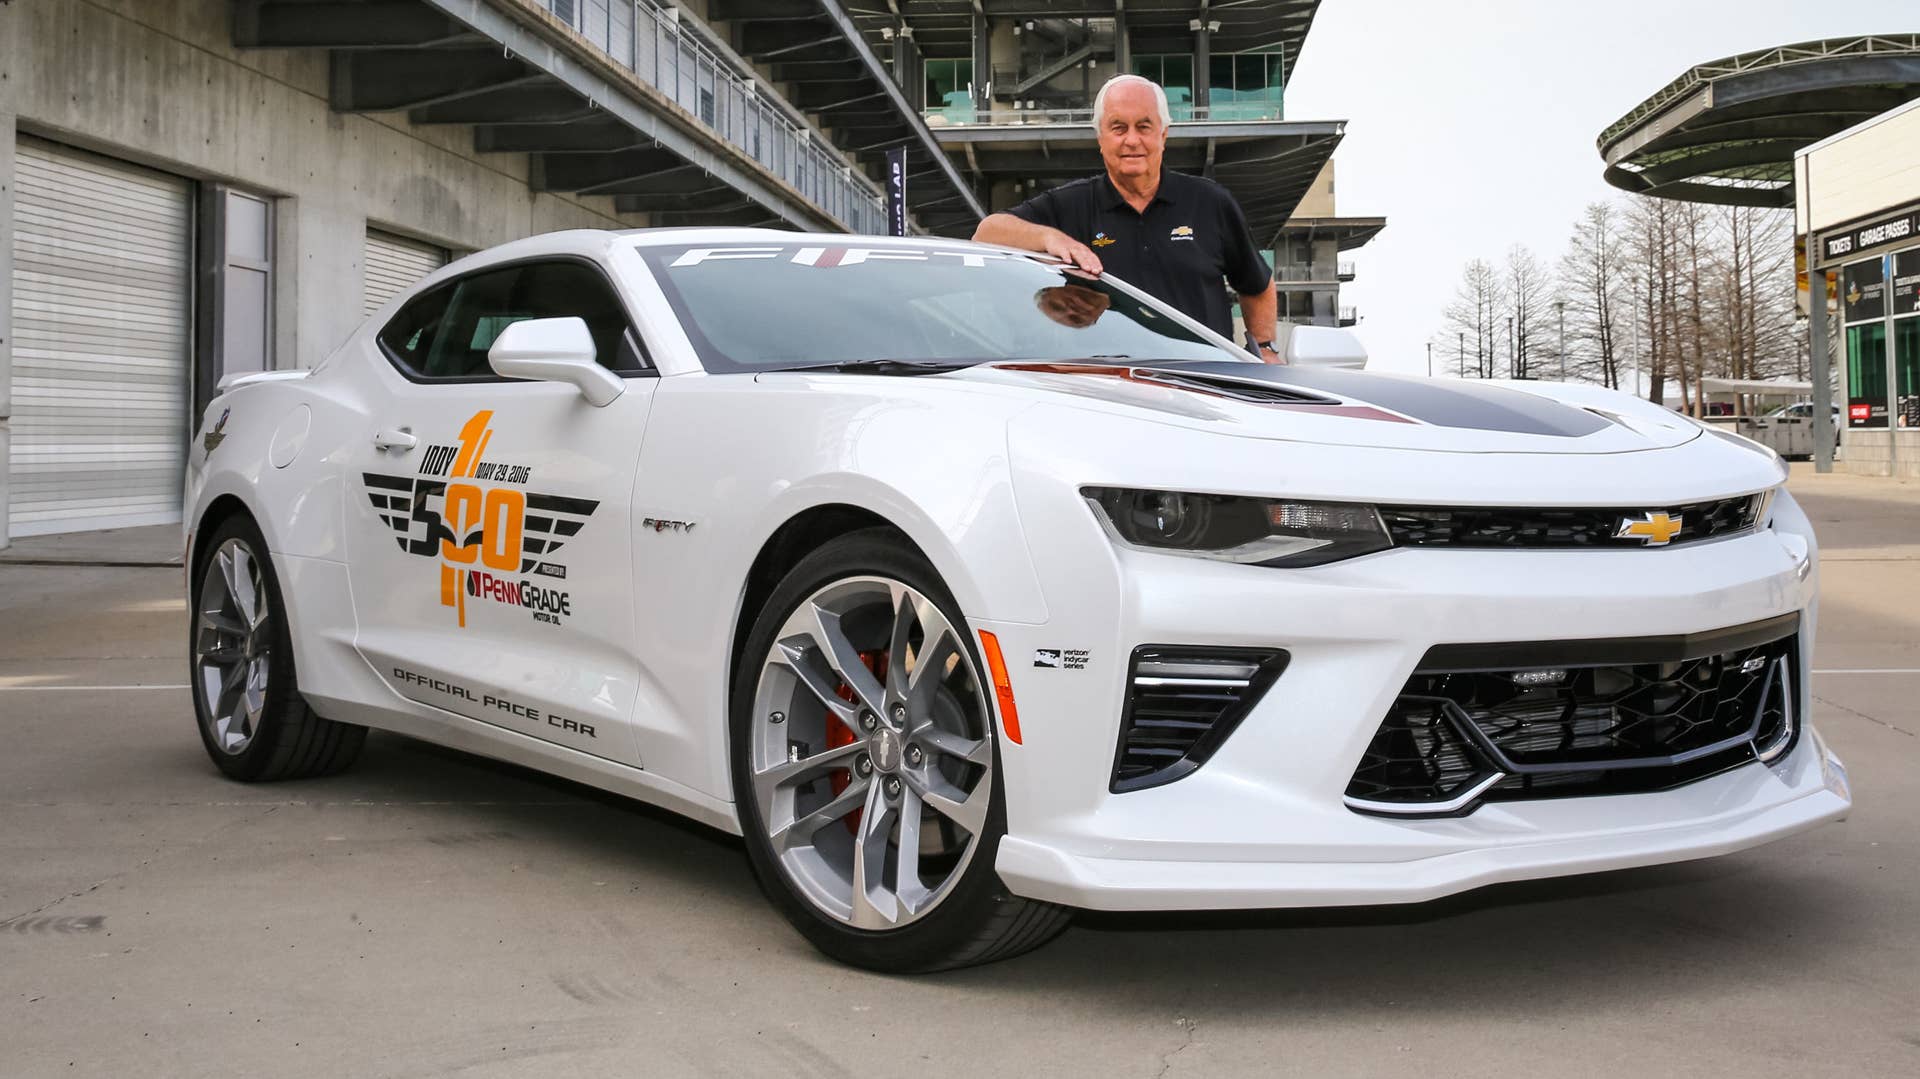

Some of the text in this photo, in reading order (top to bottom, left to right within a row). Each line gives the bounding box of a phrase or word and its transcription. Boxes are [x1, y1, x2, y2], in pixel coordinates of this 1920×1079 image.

[1828, 236, 1852, 255] TICKETS
[1859, 226, 1885, 247] GARAGE
[1884, 218, 1910, 241] PASSES
[419, 445, 458, 476] INDY
[474, 462, 497, 480] MAY
[507, 466, 531, 484] 2016
[409, 479, 524, 571] 500
[642, 517, 696, 533] FIFTY
[533, 611, 561, 626] MOTOR OIL
[393, 667, 597, 738] OFFICIAL PACE CAR
